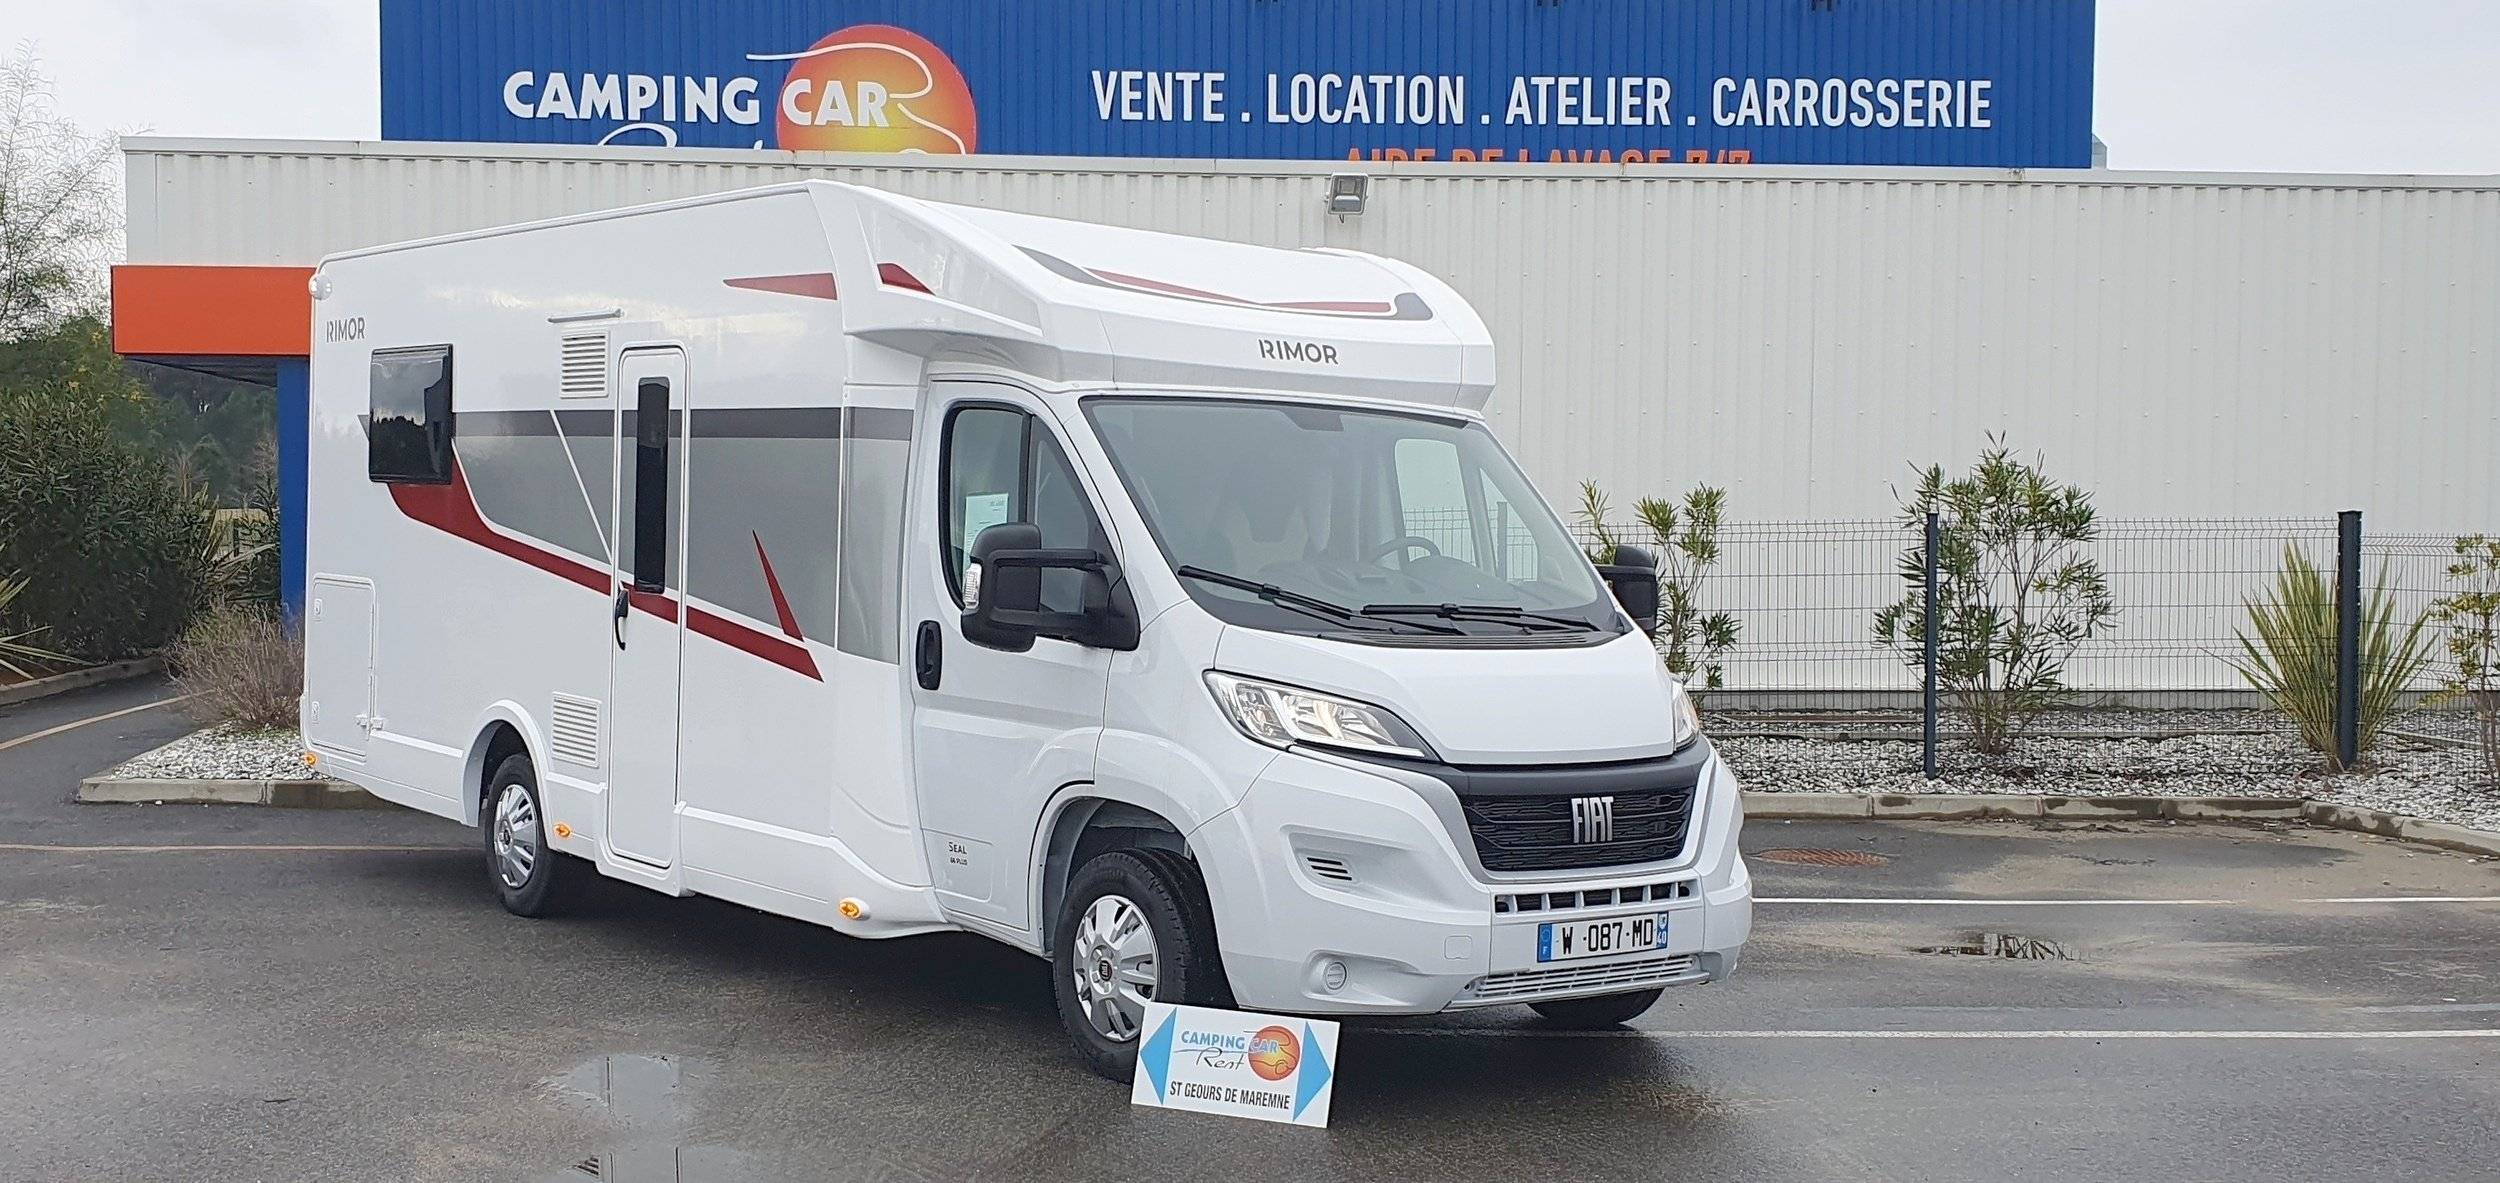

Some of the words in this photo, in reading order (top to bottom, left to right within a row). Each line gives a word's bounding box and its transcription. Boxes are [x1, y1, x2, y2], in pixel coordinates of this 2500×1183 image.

[503, 71, 760, 125] CAMPING
[782, 80, 889, 128] CAR
[1091, 71, 1225, 122] VENTE
[1267, 73, 1464, 125] LOCATION
[1504, 76, 1672, 126] ATELIER
[1712, 77, 1992, 129] CARROSSERIE
[326, 317, 365, 342] RIMOR
[1258, 339, 1339, 365] RIMOR
[1571, 796, 1614, 844] FIAT
[1181, 1030, 1245, 1050] CAMPING
[1251, 1038, 1280, 1053] CAR
[1196, 1047, 1245, 1070] Rent
[1170, 1080, 1183, 1096] ST
[1184, 1083, 1222, 1101] GEOURS
[1224, 1088, 1237, 1104] DE
[1239, 1090, 1291, 1109] MAREMNE
